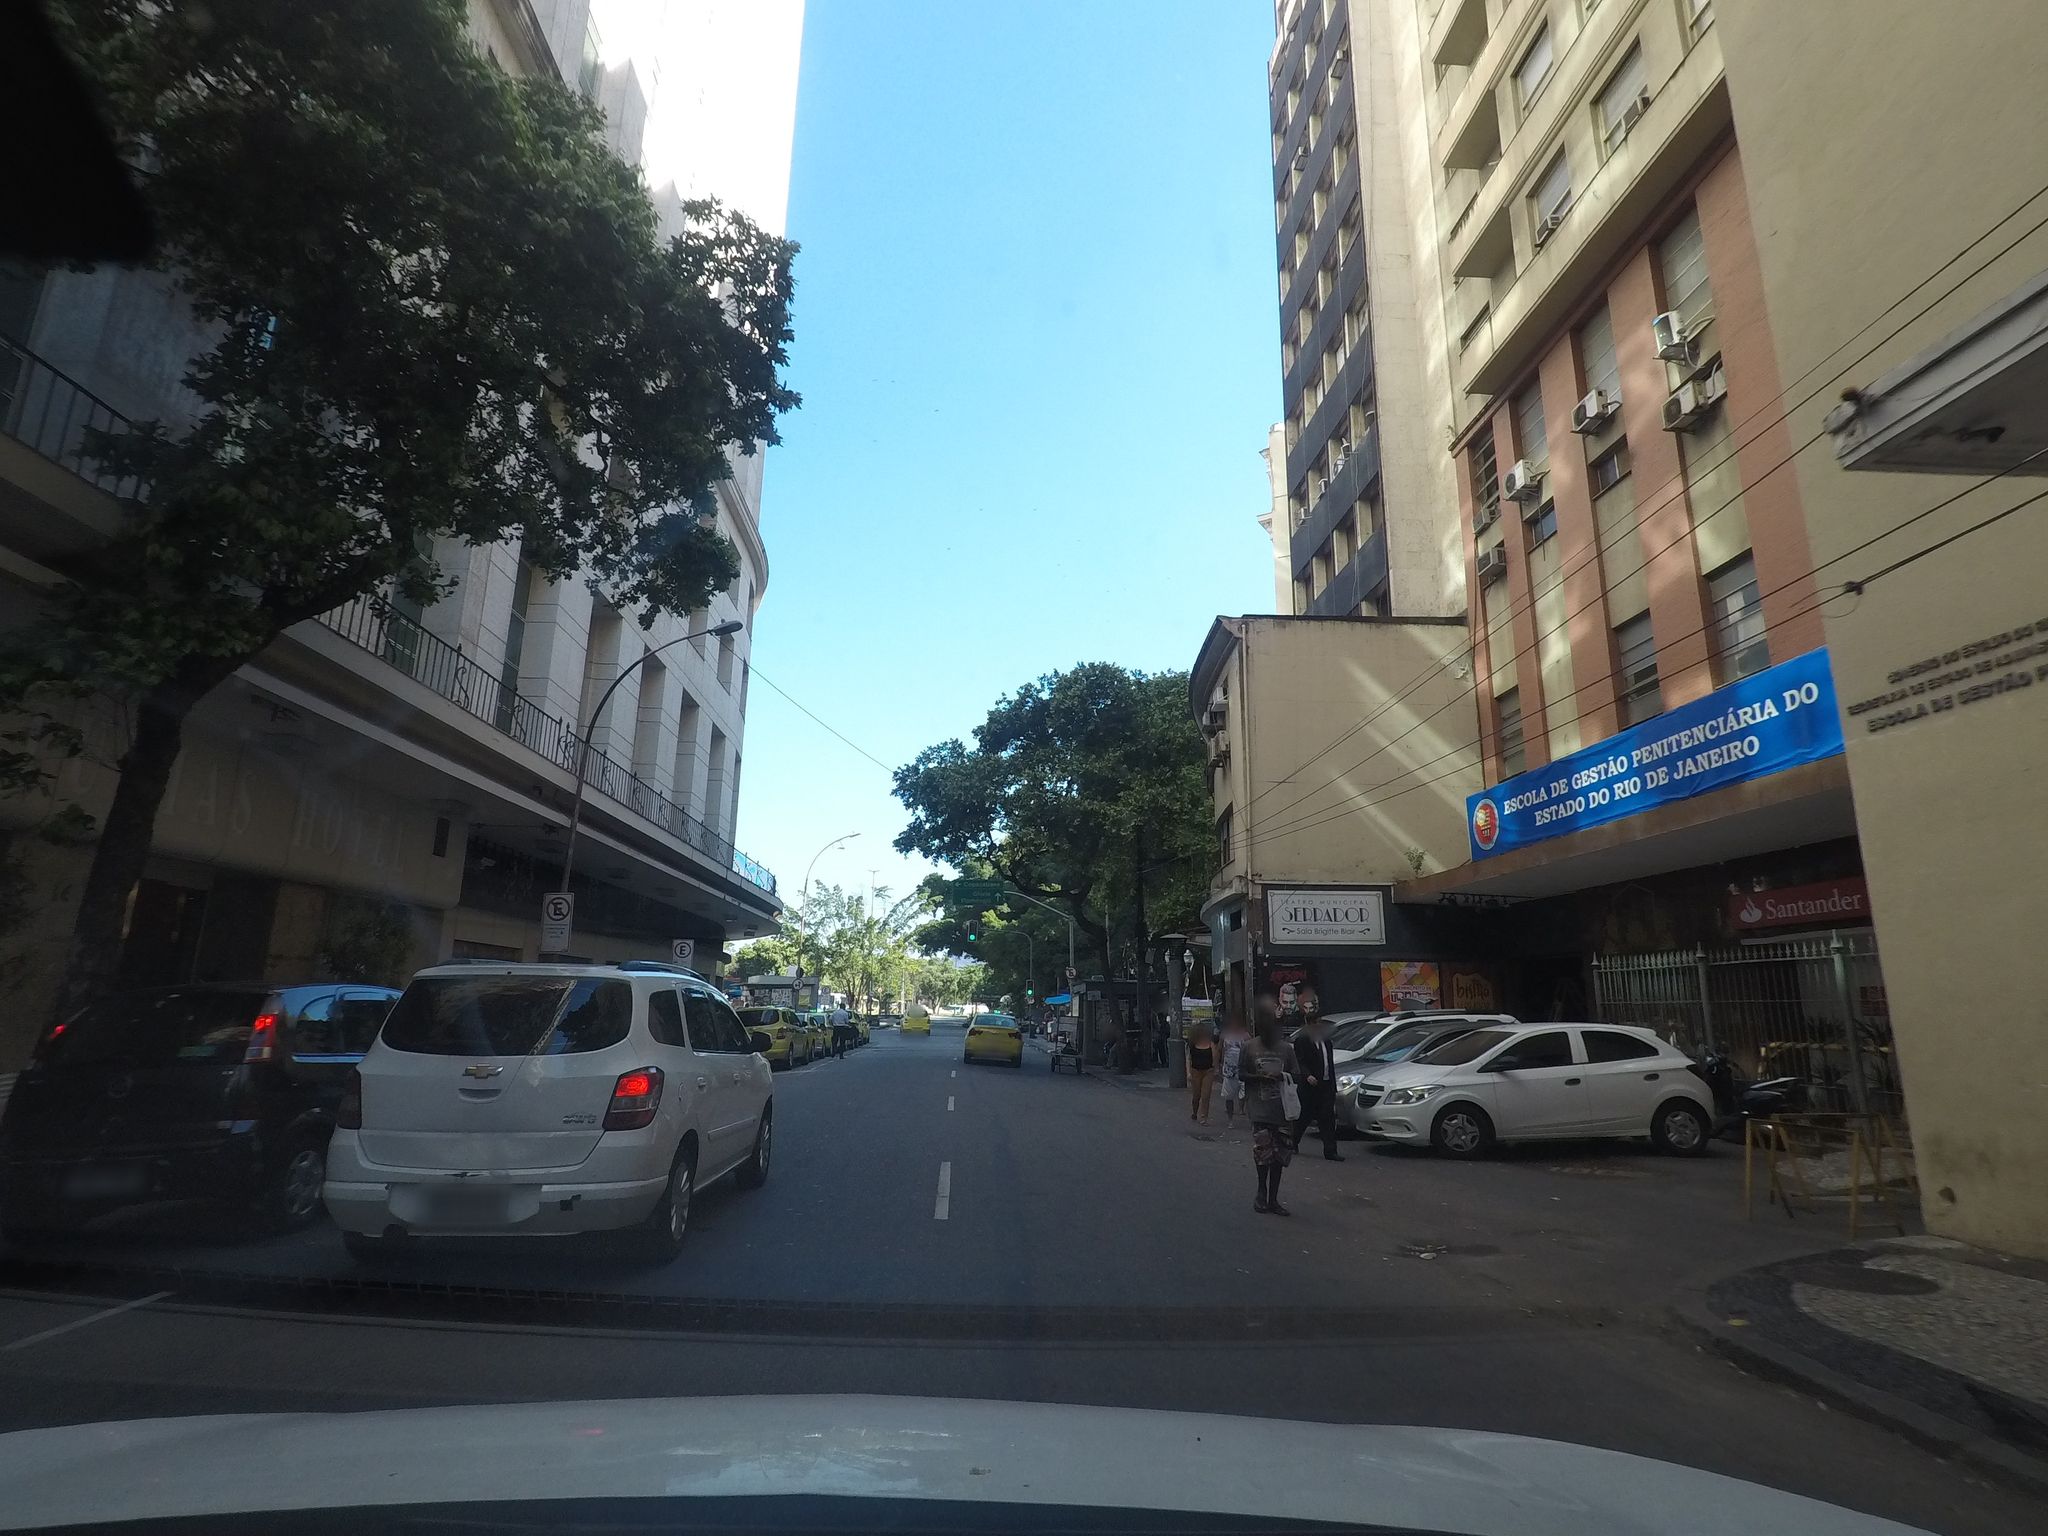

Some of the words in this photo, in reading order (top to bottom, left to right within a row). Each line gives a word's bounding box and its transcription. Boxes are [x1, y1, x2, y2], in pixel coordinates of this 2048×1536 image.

[1867, 703, 1929, 733] ESCOLA
[1930, 694, 1954, 714] DE
[1957, 672, 2034, 705] GESTÃO
[1503, 787, 1549, 815] ESCOLA
[1550, 778, 1569, 798] DE
[1572, 756, 1628, 790] GESTÃO
[1631, 699, 1779, 768] PENITENCIÁRIA
[1782, 682, 1819, 712] DO
[1534, 799, 1585, 826] ESTADO
[1588, 788, 1610, 809] DO
[1613, 777, 1641, 800] RIO
[1645, 766, 1670, 790] DE
[1673, 736, 1760, 780] JANEIRO
[1281, 907, 1370, 923] SERRADOR
[1765, 888, 1862, 920] Santander
[1296, 927, 1313, 935] Sala
[1314, 927, 1340, 936] Brigitte
[1341, 927, 1356, 935] Blair
